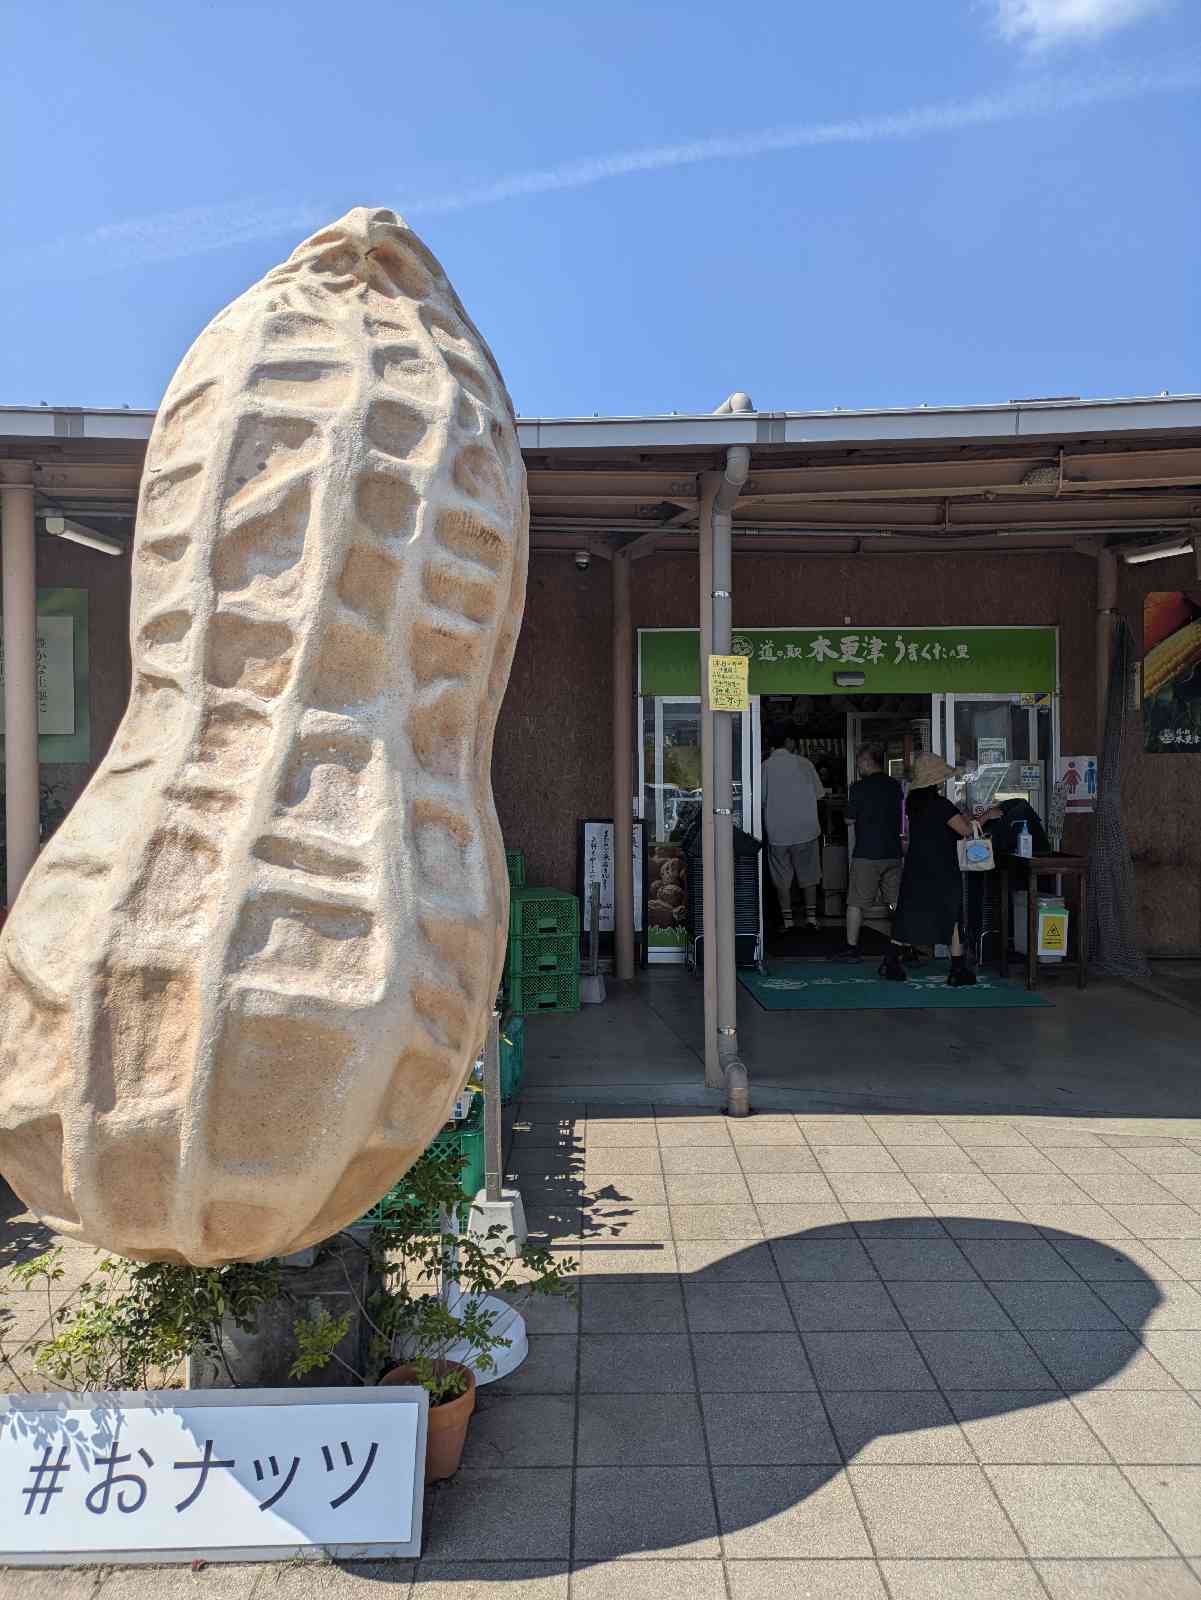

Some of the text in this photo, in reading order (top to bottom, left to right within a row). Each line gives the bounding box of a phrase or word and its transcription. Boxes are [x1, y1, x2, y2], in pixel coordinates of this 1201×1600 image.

[758, 634, 970, 664] 道の駅 木更津 うまくたの里
[22, 1439, 379, 1515] #おナッツ
